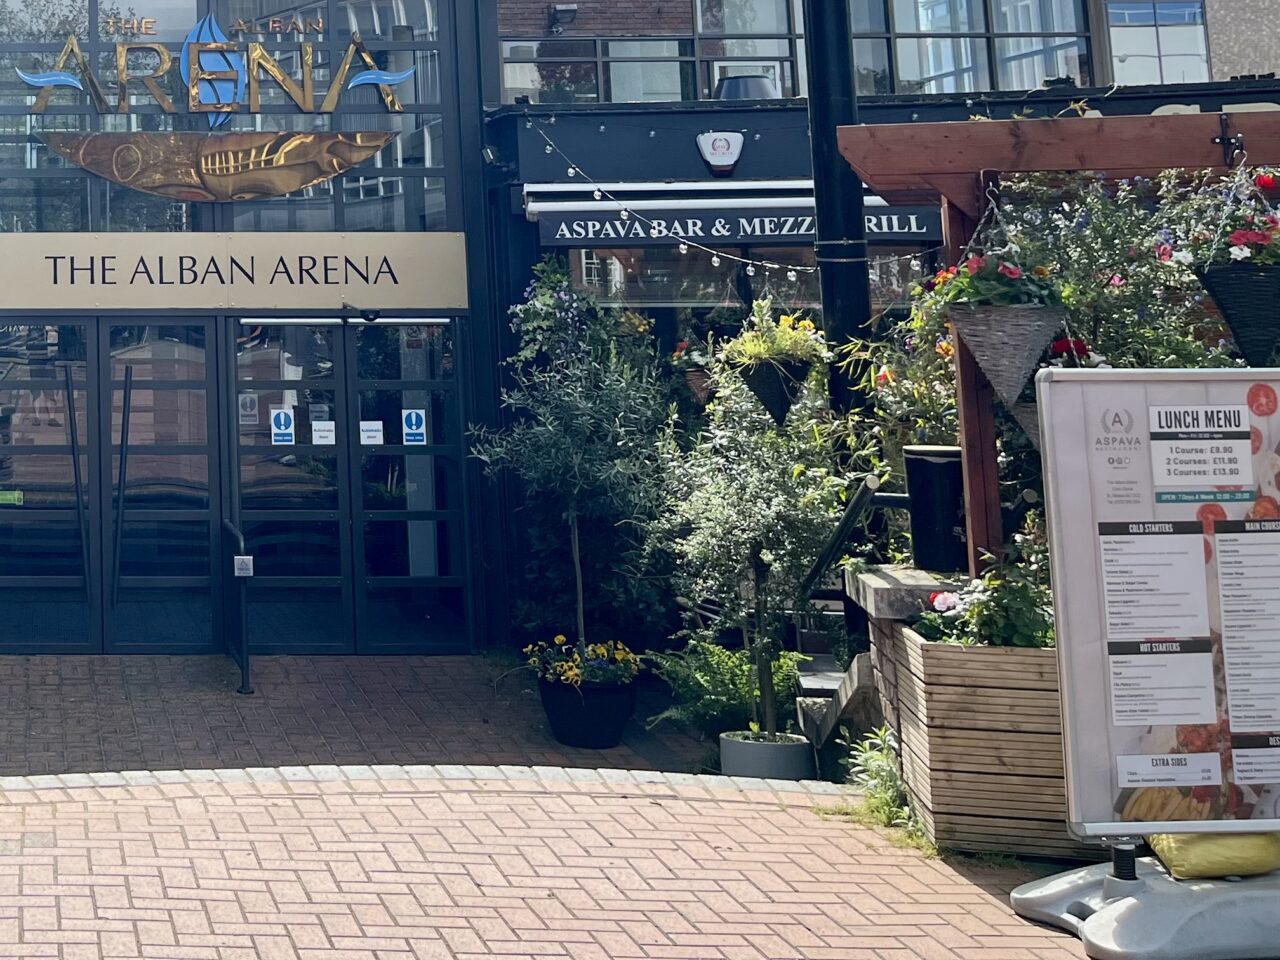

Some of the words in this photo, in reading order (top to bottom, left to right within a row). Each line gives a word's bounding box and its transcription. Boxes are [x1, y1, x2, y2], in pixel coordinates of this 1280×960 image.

[105, 17, 158, 36] THE
[230, 17, 324, 35] ALBAN
[17, 31, 414, 114] ARENA
[555, 220, 646, 240] ASPAVA
[650, 218, 705, 238] BAR
[710, 217, 732, 236] &
[738, 216, 816, 237] MEZZ
[864, 214, 928, 233] RILL
[44, 255, 117, 285] THE
[129, 255, 256, 285] ALBAN
[269, 254, 399, 285] ARENA
[1111, 412, 1123, 427] A
[1157, 410, 1200, 429] LUNCH
[1204, 409, 1241, 428] MENU
[1095, 436, 1142, 446] ASPAVA
[1128, 524, 1144, 533] COLD
[1144, 523, 1174, 533] STARTERS
[1244, 522, 1261, 531] MAIN
[1139, 643, 1151, 652] HOT
[1152, 642, 1181, 652] STARTERS
[1151, 758, 1170, 767] EXTRA
[1171, 757, 1188, 766] SIDES
